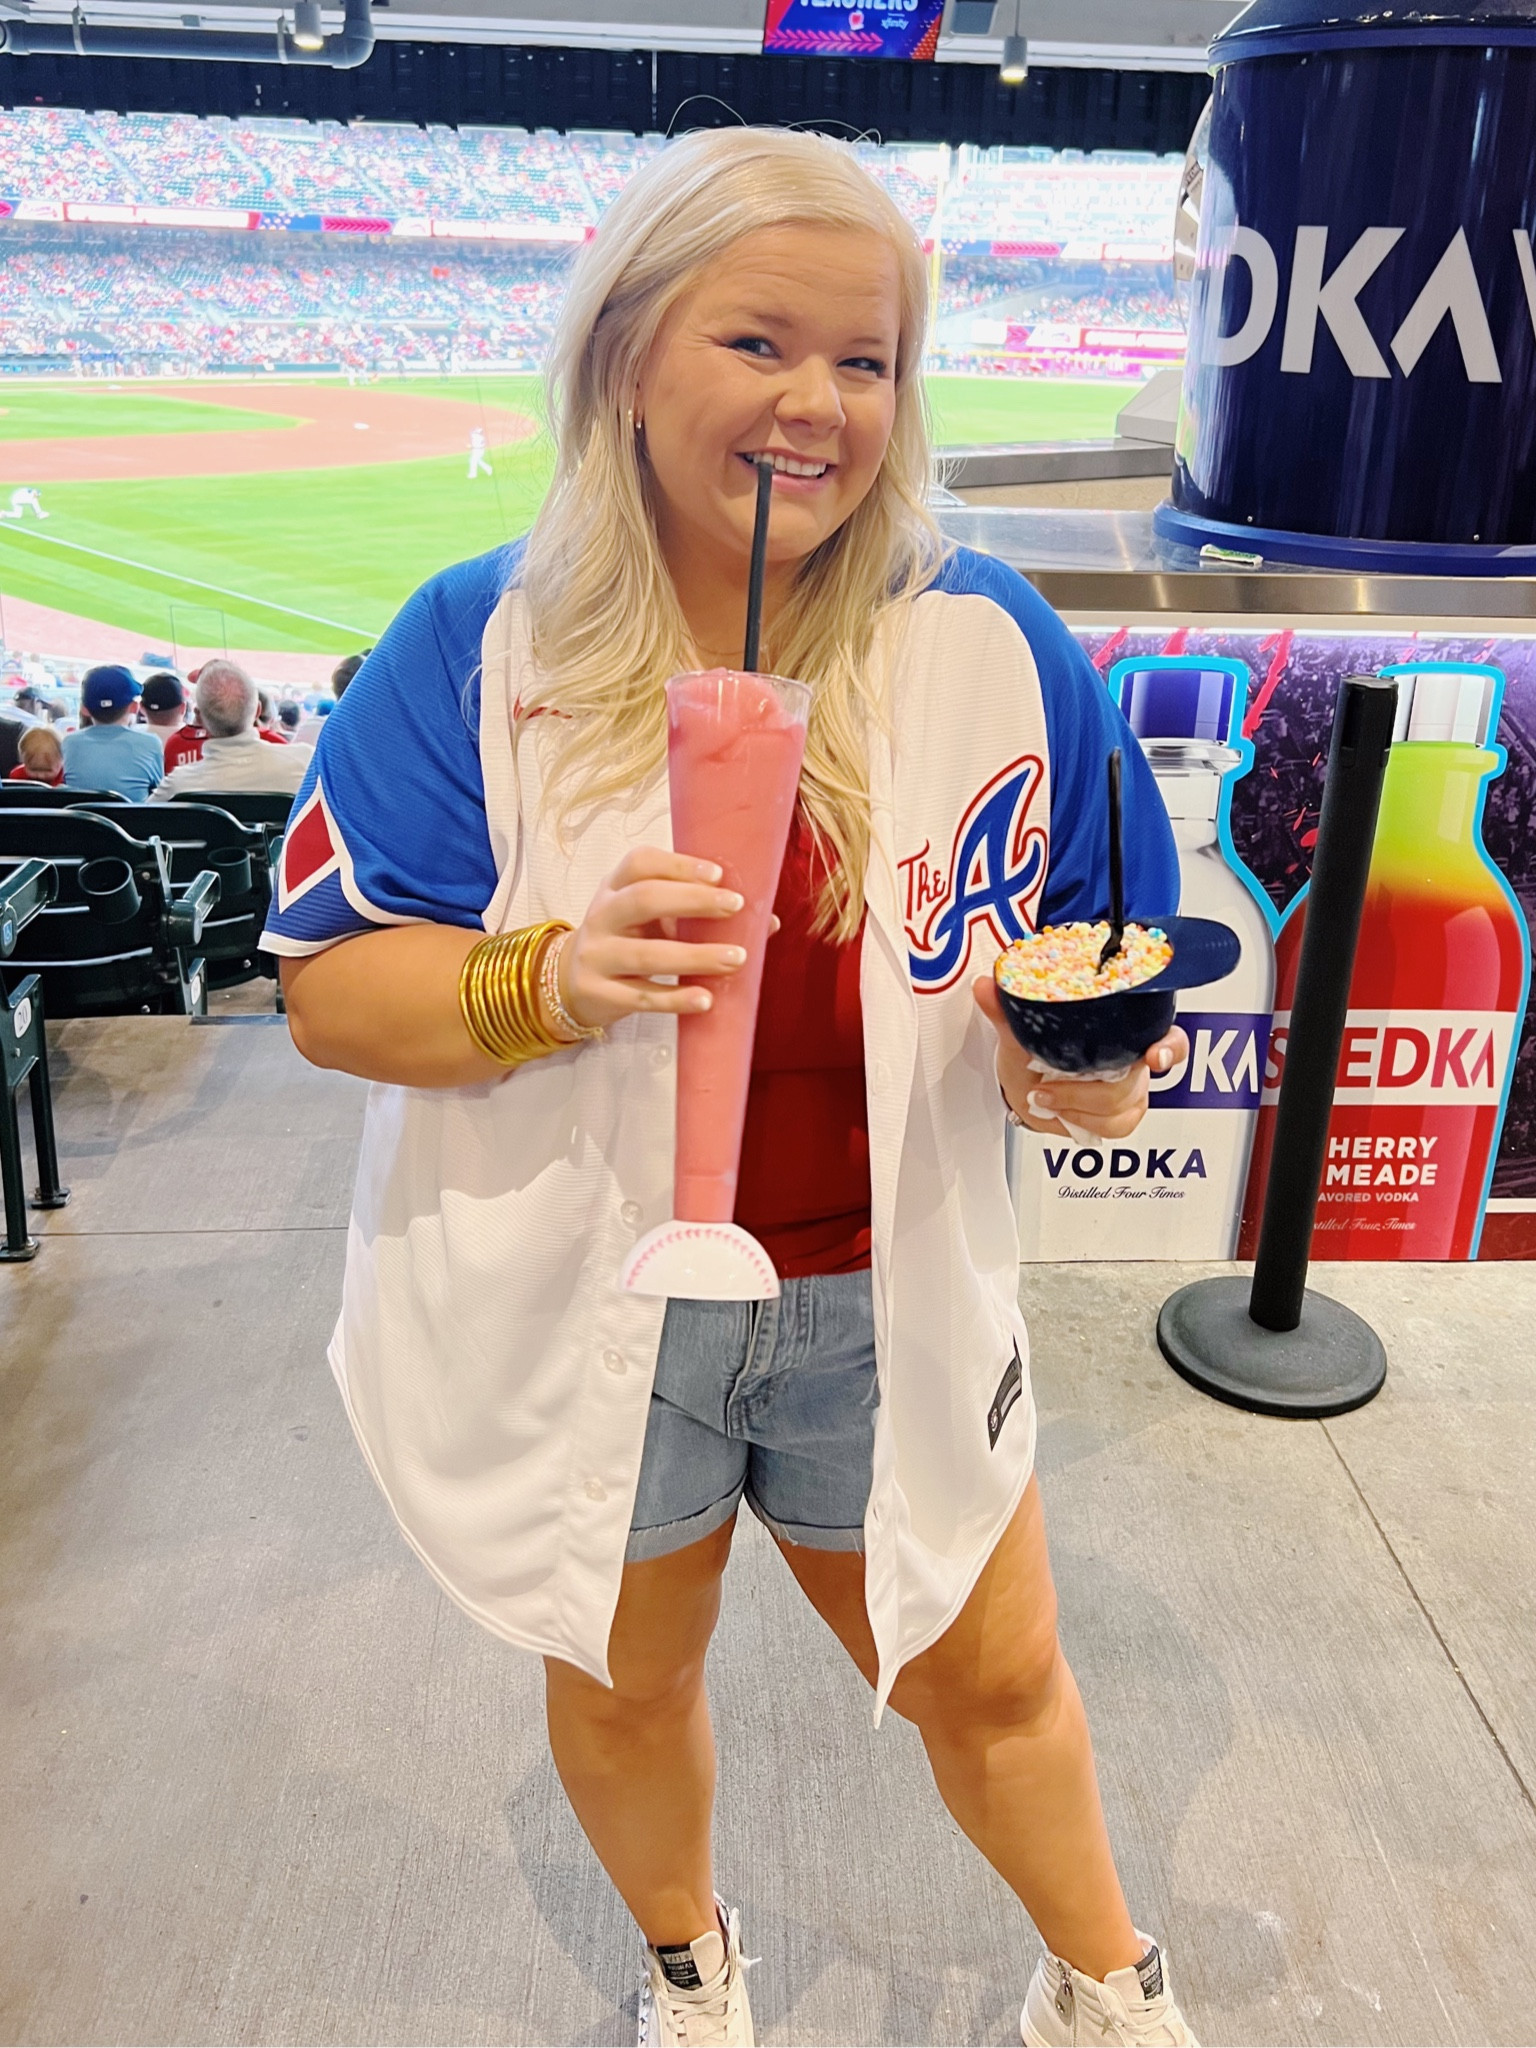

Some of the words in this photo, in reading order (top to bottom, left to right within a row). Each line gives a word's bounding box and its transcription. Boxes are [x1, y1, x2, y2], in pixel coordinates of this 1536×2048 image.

[1202, 225, 1502, 382] DKA
[897, 839, 946, 920] The
[904, 755, 1047, 994] A
[1264, 1027, 1494, 1089] SEDKA
[1328, 1136, 1438, 1159] HERRY
[1043, 1148, 1207, 1179] VODKA
[1326, 1164, 1438, 1186] MEADE
[1058, 1186, 1112, 1199] Distilled
[1112, 1186, 1147, 1199] Four
[1149, 1186, 1185, 1199] Times
[1317, 1192, 1371, 1203] AVORED
[1375, 1192, 1419, 1203] VODKA
[1313, 1218, 1349, 1230] stilled
